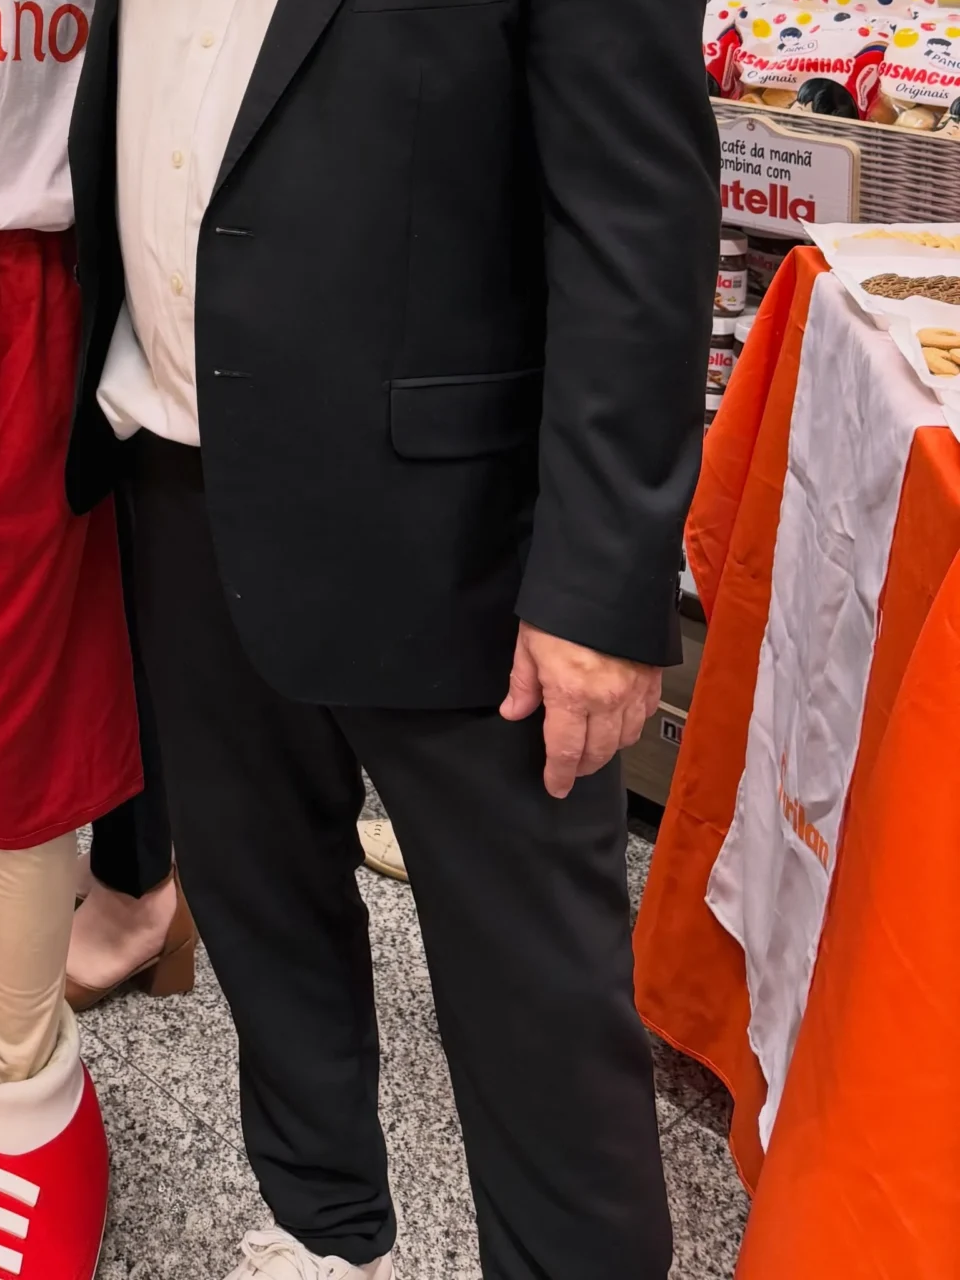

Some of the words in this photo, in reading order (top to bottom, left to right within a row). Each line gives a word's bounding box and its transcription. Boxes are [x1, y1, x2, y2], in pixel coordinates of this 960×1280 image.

[895, 82, 950, 100] Originais
[721, 139, 746, 156] café
[750, 142, 765, 160] da
[770, 149, 812, 168] manhã
[720, 156, 761, 177] ombina
[766, 165, 791, 182] com
